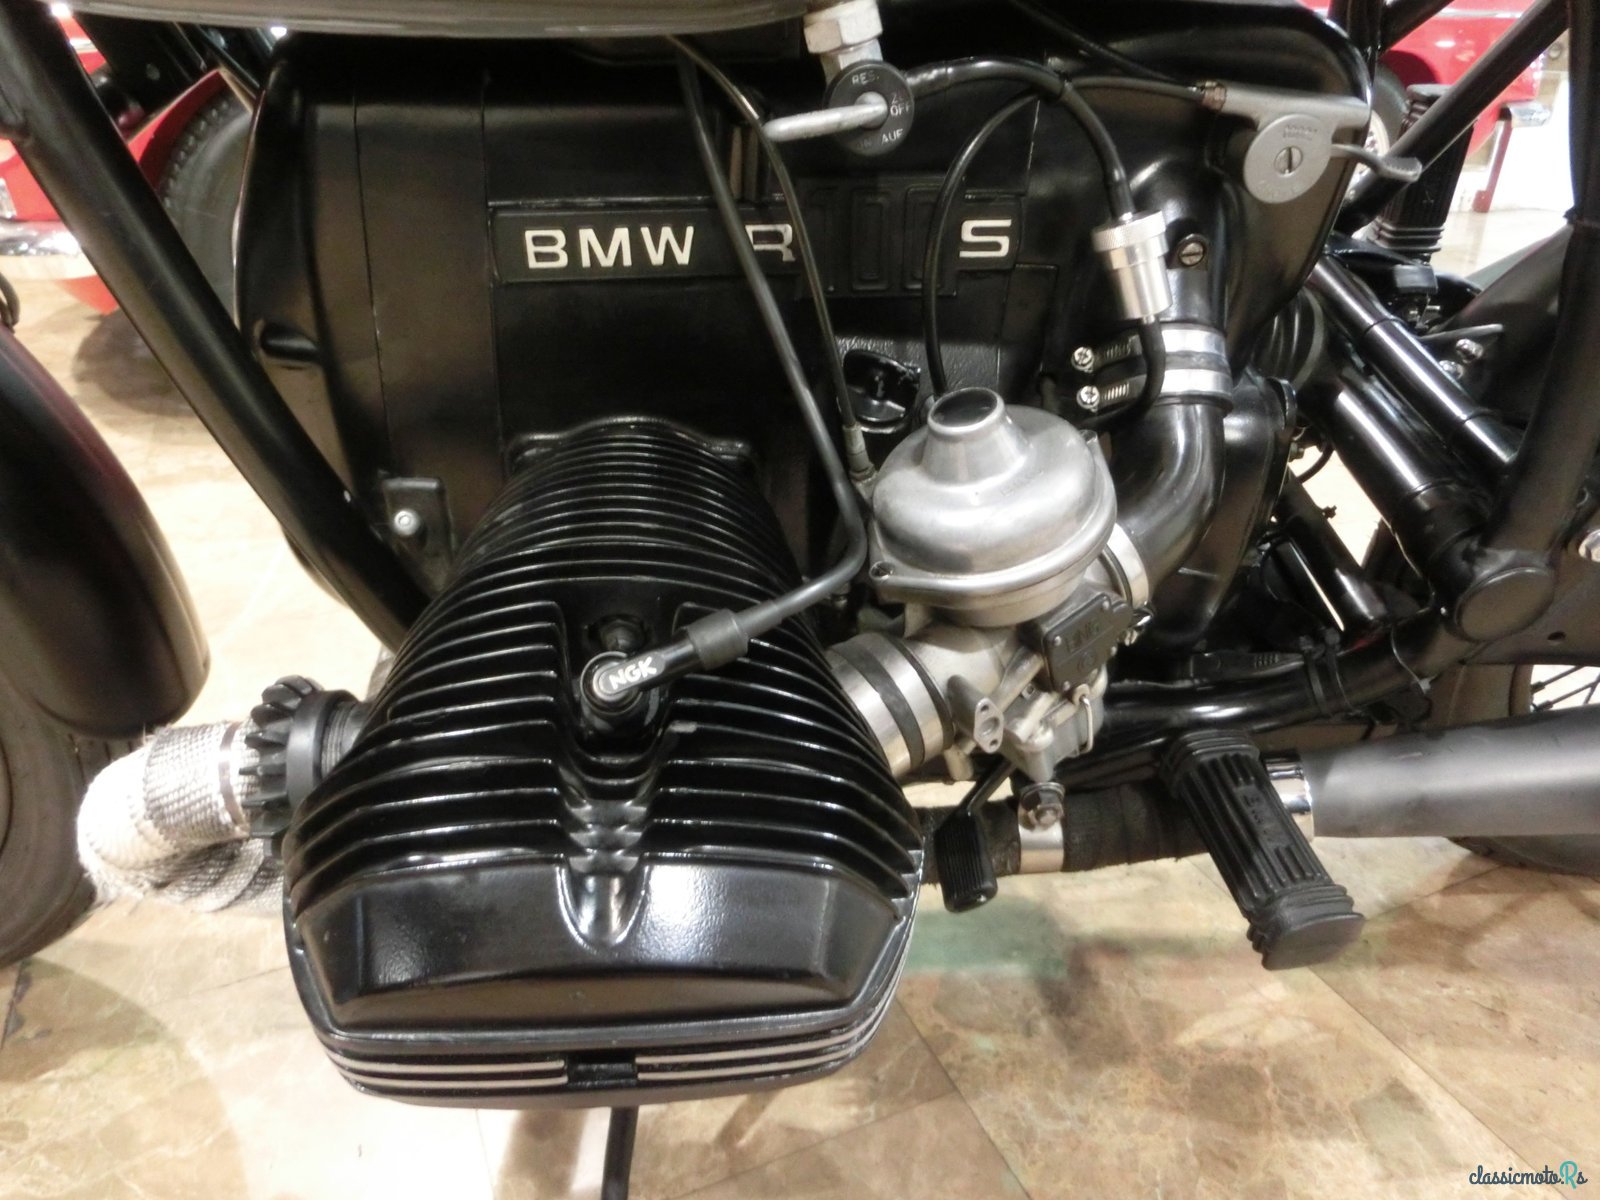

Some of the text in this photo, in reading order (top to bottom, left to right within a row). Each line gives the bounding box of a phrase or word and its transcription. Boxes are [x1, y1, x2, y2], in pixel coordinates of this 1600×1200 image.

[890, 102, 910, 117] OFF
[881, 128, 903, 144] AUF
[524, 225, 695, 269] BMW
[745, 223, 796, 262] R
[959, 219, 1012, 258] S
[608, 656, 657, 690] NGK
